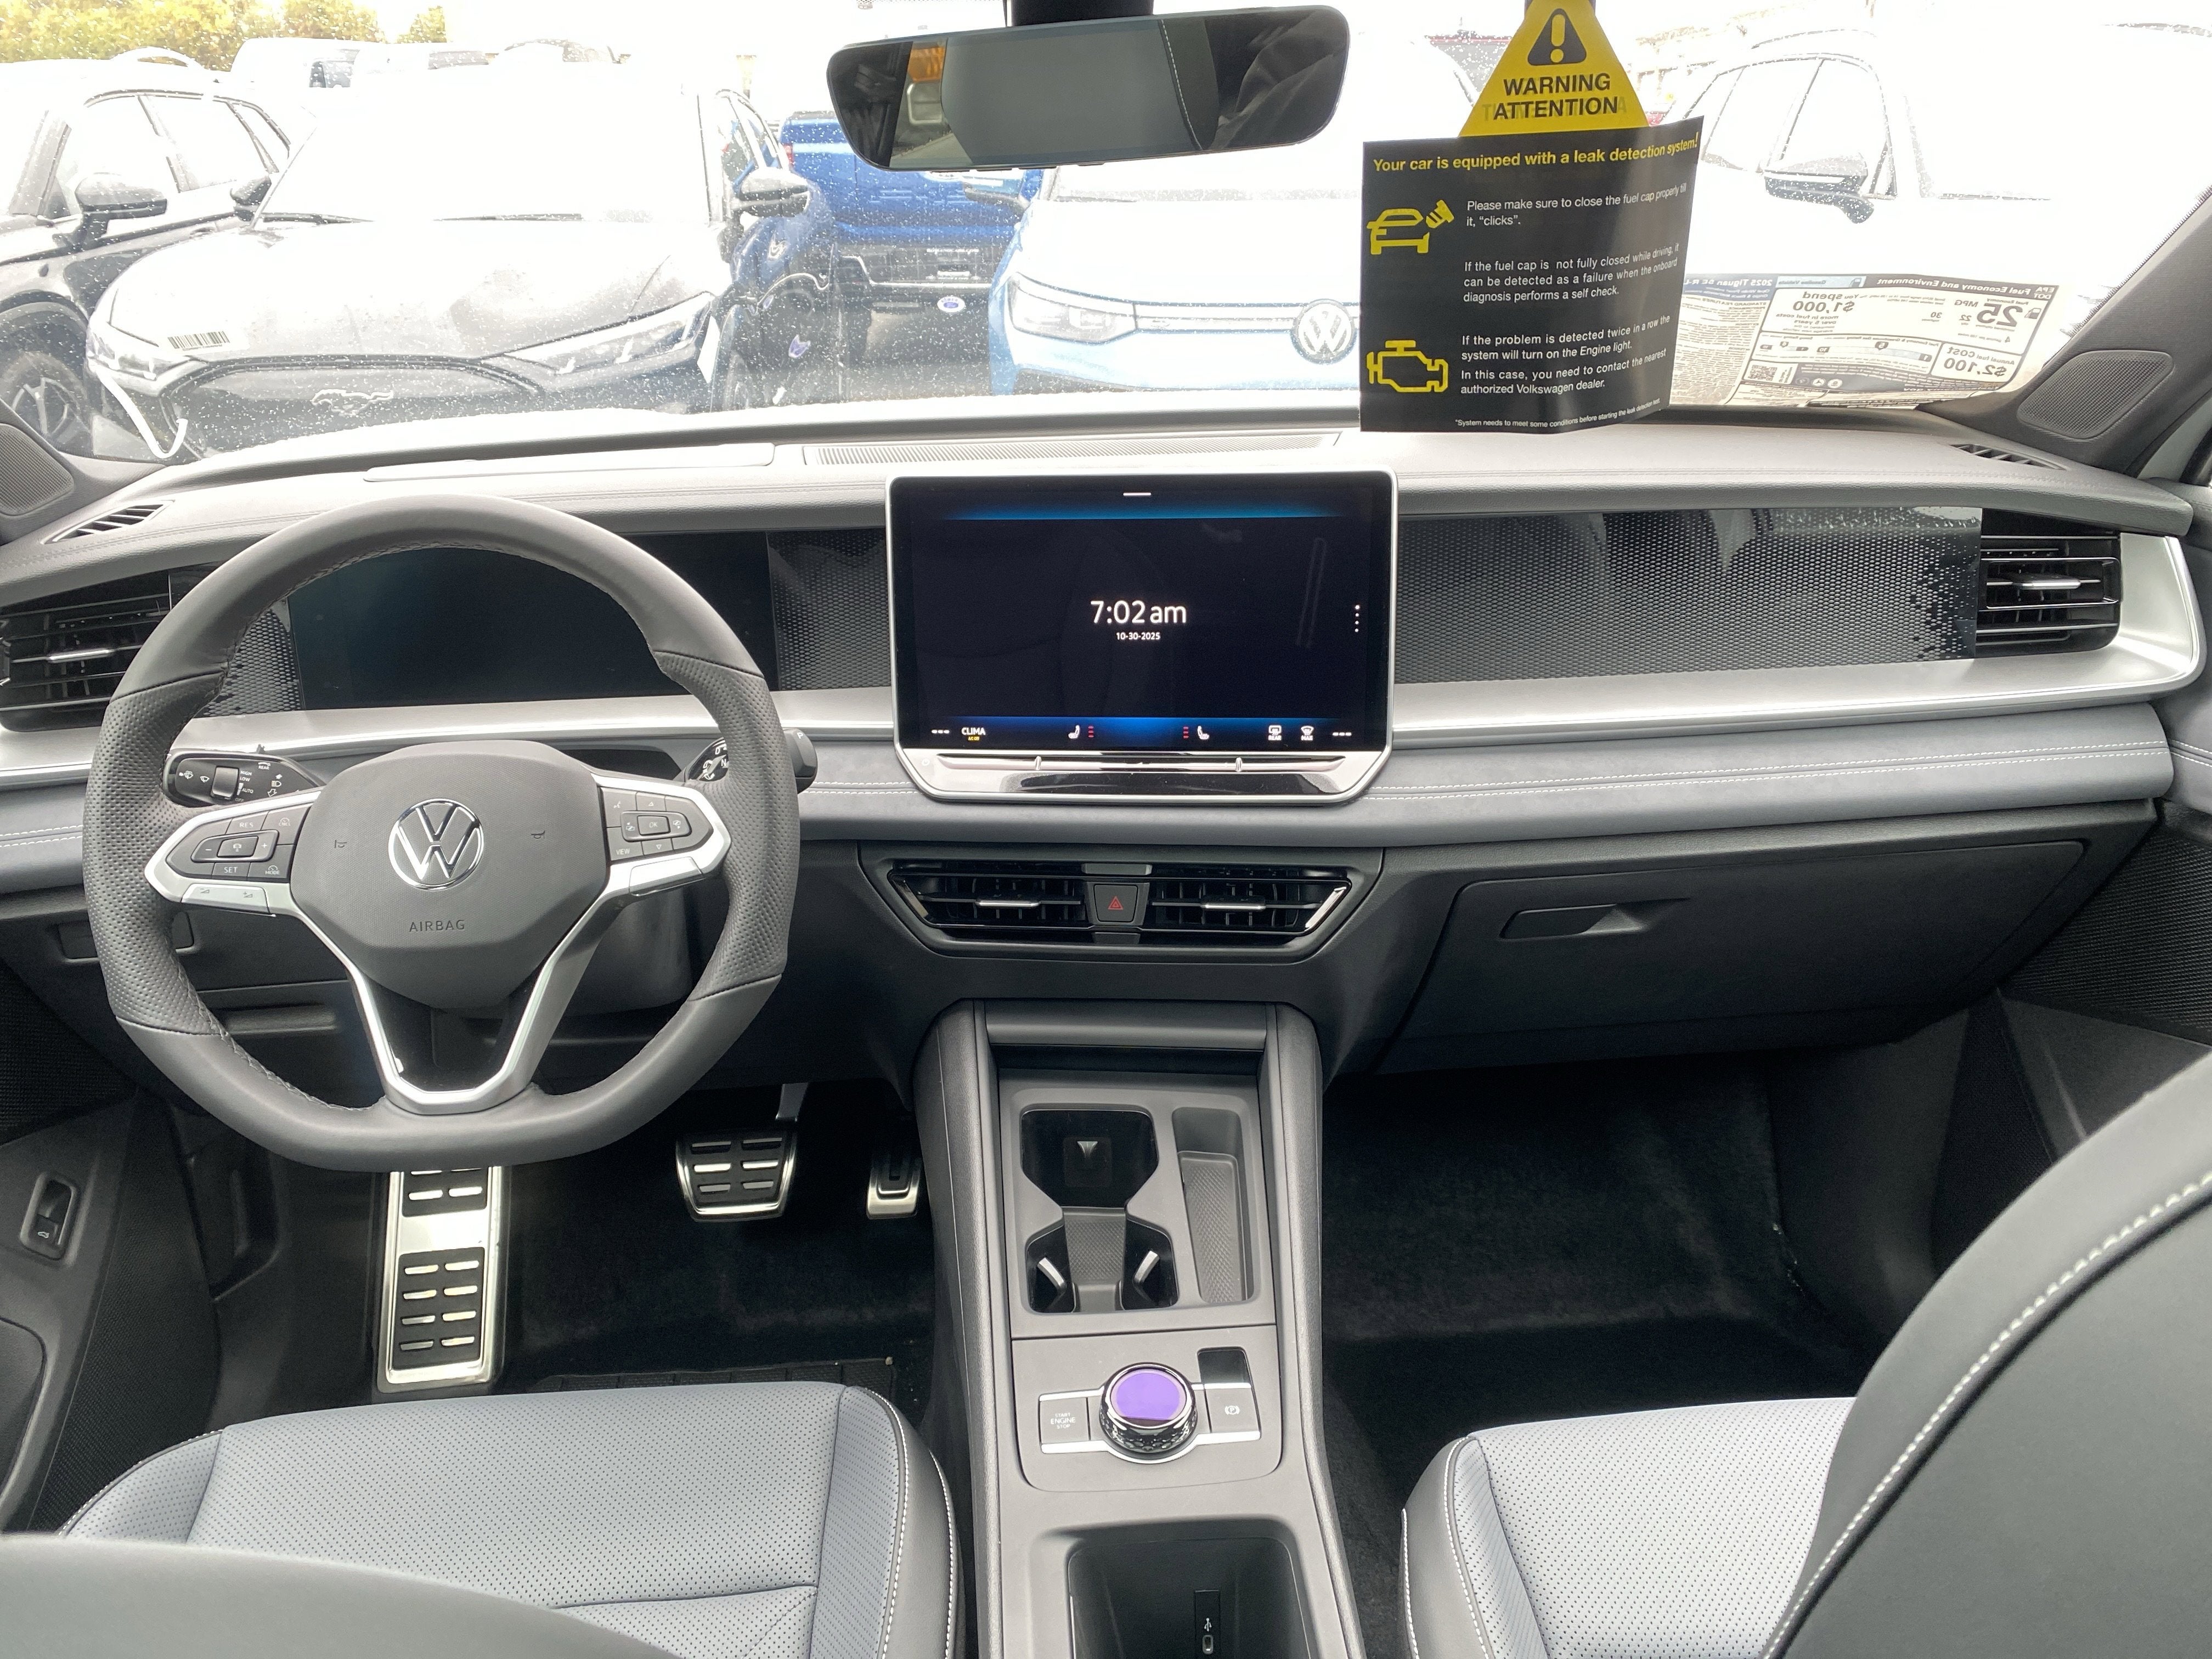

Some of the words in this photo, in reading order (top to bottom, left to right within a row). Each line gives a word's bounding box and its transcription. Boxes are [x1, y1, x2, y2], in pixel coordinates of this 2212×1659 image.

[1504, 73, 1610, 96] WARNING
[1493, 97, 1617, 120] ATTENTION
[1374, 159, 1406, 171] Your
[1410, 160, 1433, 170] car
[1437, 156, 1449, 169] is
[1453, 153, 1520, 171] equipped
[1525, 151, 1556, 165] with
[1560, 153, 1570, 163] a
[1574, 149, 1605, 163] leak
[1610, 146, 1665, 161] detection
[1667, 132, 1699, 156] system!
[1467, 201, 1502, 211] Please
[1504, 199, 1532, 210] make
[1536, 200, 1558, 208] sure
[1561, 198, 1572, 207] to
[1575, 196, 1602, 207] close
[1605, 195, 1621, 206] the
[1623, 193, 1639, 204] fuel
[1640, 192, 1654, 203] cap
[1656, 184, 1679, 201] properly
[1466, 216, 1476, 228] it,
[1465, 262, 1472, 272] If
[1475, 262, 1491, 272] the
[1495, 261, 1514, 270] fuel
[1517, 262, 1537, 272] cap
[1541, 259, 1549, 269] is
[1556, 259, 1573, 269] not
[1577, 257, 1598, 270] fully
[1600, 254, 1630, 266] closed
[1632, 251, 1650, 262] while
[1652, 246, 1673, 259] driving,
[1675, 242, 1679, 252] it
[1464, 278, 1483, 287] can
[1487, 276, 1500, 286] be
[1504, 275, 1553, 286] detected
[1556, 275, 1569, 284] as
[1573, 275, 1579, 284] a
[1583, 273, 1613, 283] failure
[1616, 269, 1638, 279] when
[1641, 266, 1651, 276] the
[1654, 257, 1678, 273] onboard
[1463, 291, 1511, 304] diagnosis
[1514, 290, 1559, 303] performs
[1562, 291, 1568, 300] a
[1572, 288, 1589, 299] self
[1591, 285, 1620, 297] check.
[1462, 336, 1470, 345] If
[1474, 335, 1491, 345] the
[1495, 334, 1541, 347] problem
[1545, 334, 1555, 343] is
[1559, 329, 1604, 343] detected
[1607, 327, 1630, 337] twice
[1633, 324, 1640, 333] in
[1647, 319, 1658, 329] row
[1660, 315, 1670, 325] the
[1462, 351, 1498, 362] system
[1502, 350, 1519, 359] will
[1522, 350, 1543, 359] turn
[1546, 351, 1559, 359] on
[1562, 348, 1577, 357] the
[1580, 344, 1611, 357] Engine
[1613, 340, 1632, 353] light.
[1462, 370, 1471, 379] In
[1475, 370, 1495, 379] this
[1499, 371, 1528, 380] case,
[1532, 371, 1552, 381] you
[1556, 366, 1579, 378] need
[1583, 366, 1593, 375] to
[1596, 359, 1629, 374] contact
[1632, 357, 1643, 367] the
[1644, 348, 1666, 364] nearest
[1460, 384, 1514, 394] authorized
[1516, 383, 1573, 395] Volkswagen
[1576, 379, 1605, 390] dealer.
[1550, 418, 1578, 427] conditions
[1598, 411, 1617, 420] starting
[1636, 401, 1652, 411] detection
[1116, 631, 1161, 640] 10-30-2025
[409, 919, 465, 932] AIRBAG
